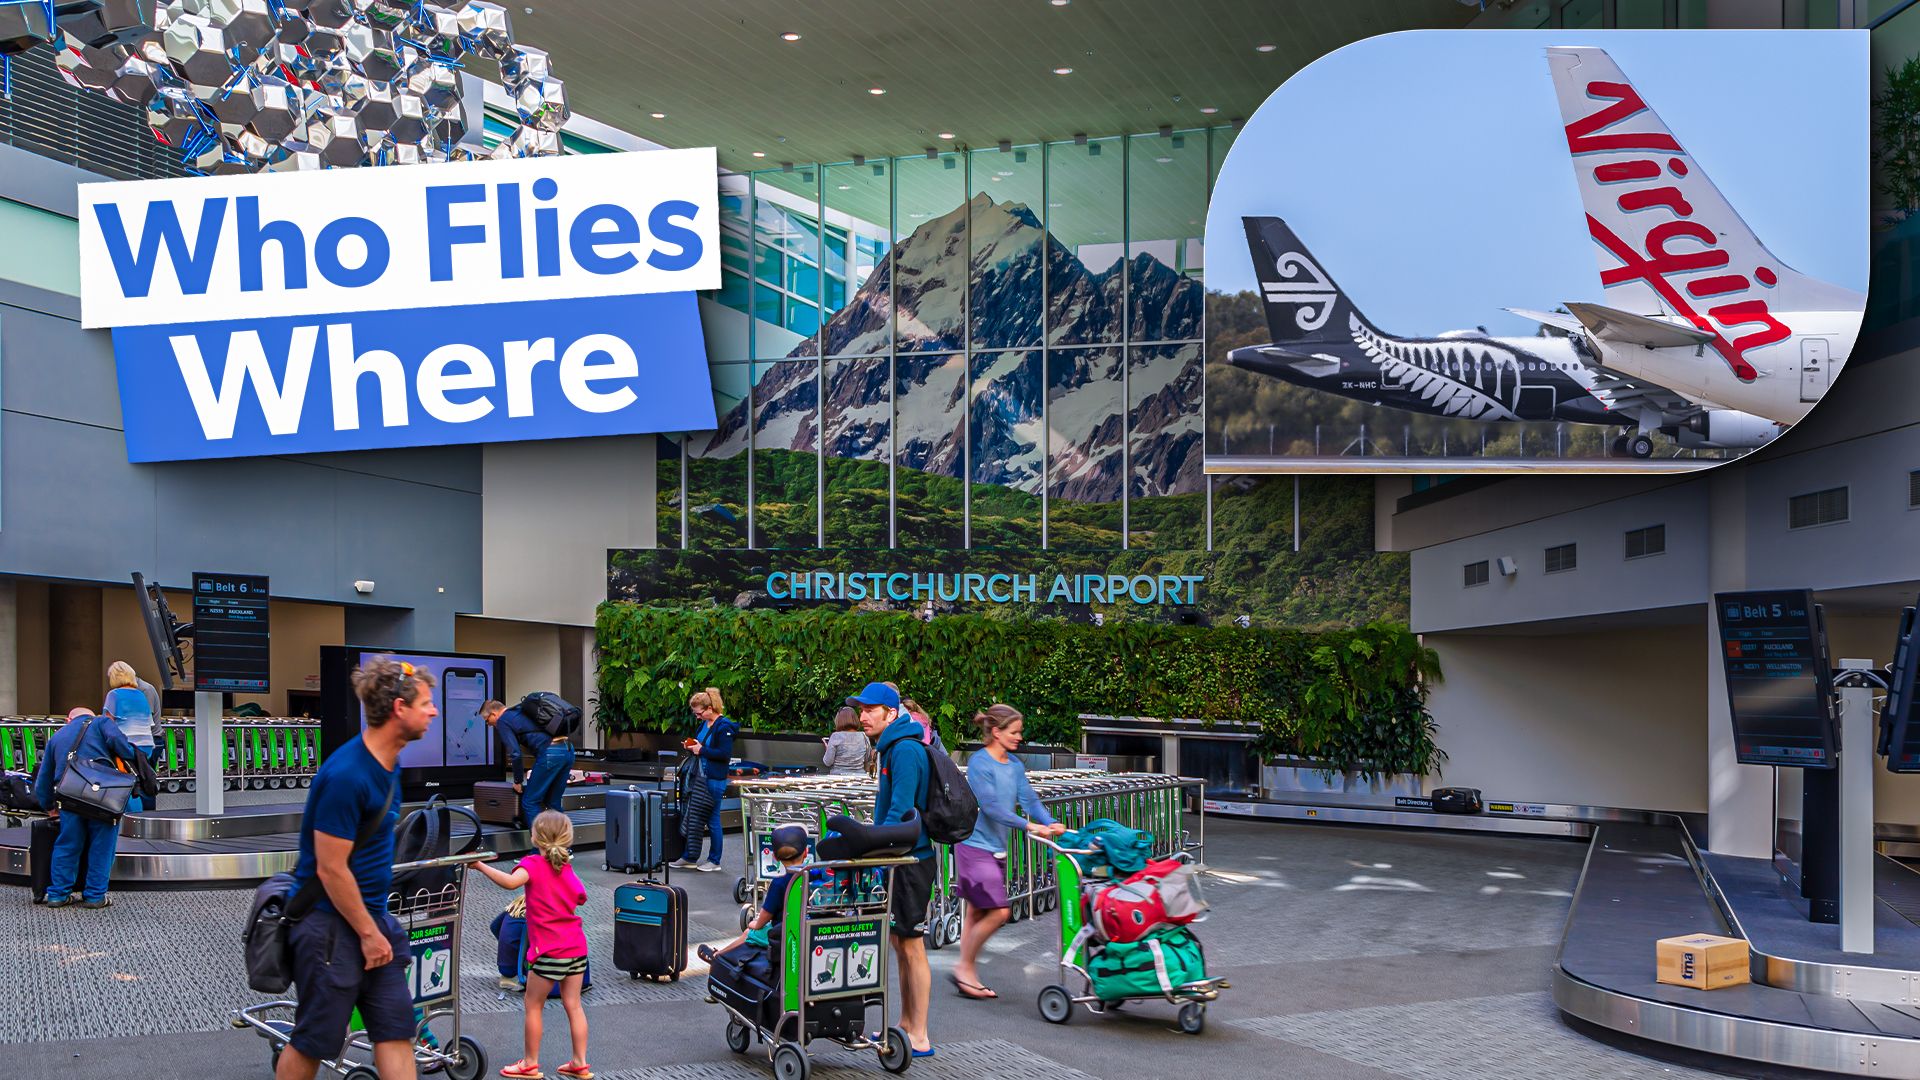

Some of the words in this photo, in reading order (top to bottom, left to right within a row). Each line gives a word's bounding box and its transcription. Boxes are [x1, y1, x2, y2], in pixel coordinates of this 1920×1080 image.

[1565, 81, 1792, 382] Virgin
[1341, 381, 1377, 389] ZK-NHC
[216, 582, 236, 592] Belt
[240, 583, 247, 593] 6
[766, 571, 1036, 603] CHRISTCHURCH
[1047, 573, 1205, 605] AIRPORT
[1743, 605, 1767, 618] Belt
[1771, 603, 1782, 617] 5
[411, 931, 423, 939] OUR
[424, 926, 446, 936] SAFETY
[818, 926, 831, 935] FOR
[832, 925, 850, 933] YOUR
